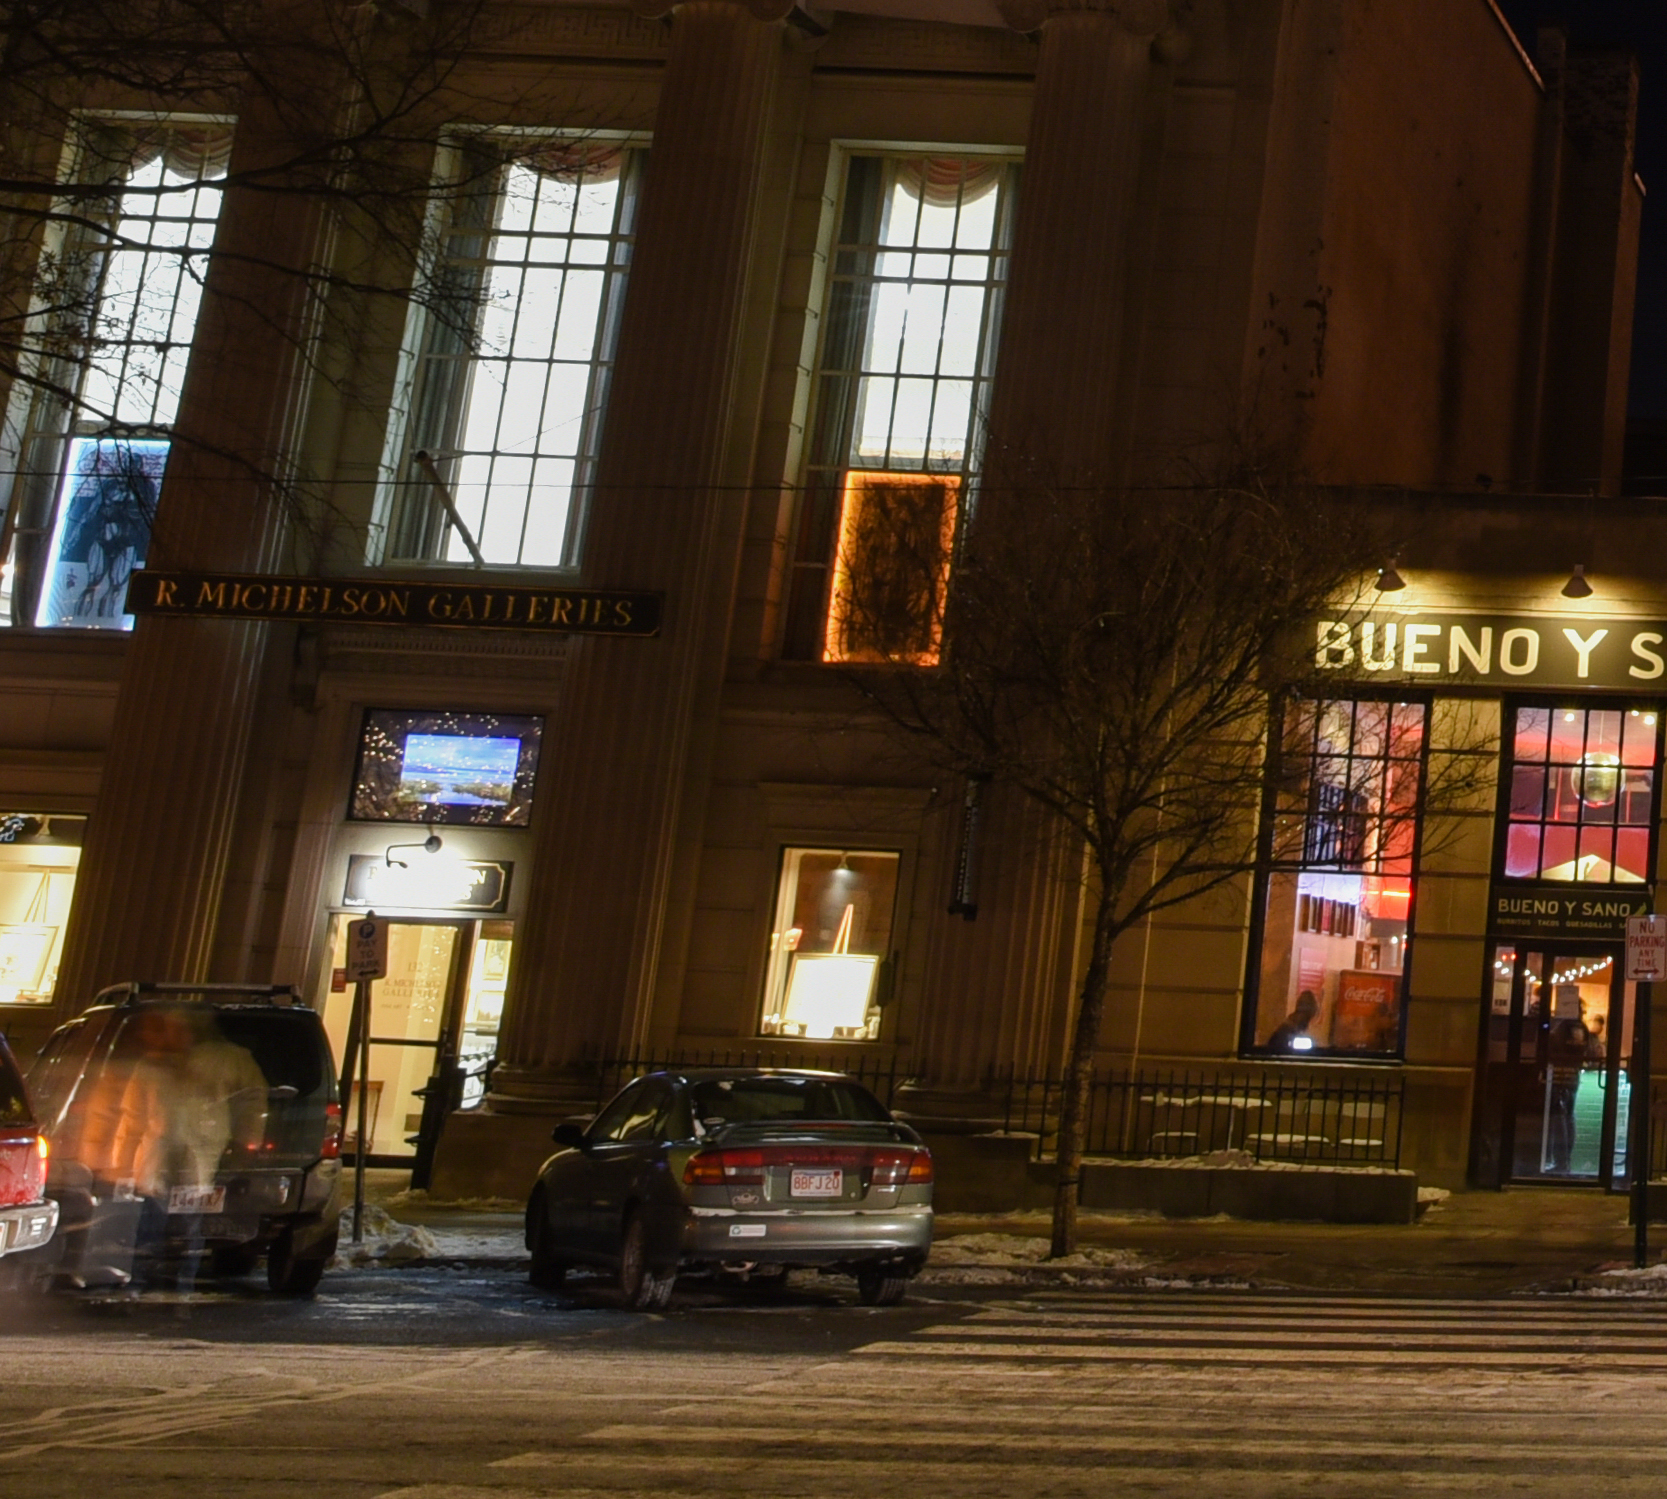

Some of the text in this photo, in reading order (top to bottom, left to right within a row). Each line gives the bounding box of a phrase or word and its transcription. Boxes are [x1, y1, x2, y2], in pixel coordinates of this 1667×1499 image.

[152, 578, 634, 628] R. MICHELSON GALLERIES
[1314, 620, 1541, 676] BUENO
[1562, 628, 1609, 678] Y
[1498, 898, 1631, 918] BUENO Y SANO
[1639, 921, 1655, 934] NO
[356, 940, 377, 948] PAY
[1629, 935, 1666, 948] PARKING
[360, 950, 373, 958] TO
[1638, 948, 1655, 958] ANY
[351, 960, 381, 969] PARK
[1637, 958, 1656, 968] TIME
